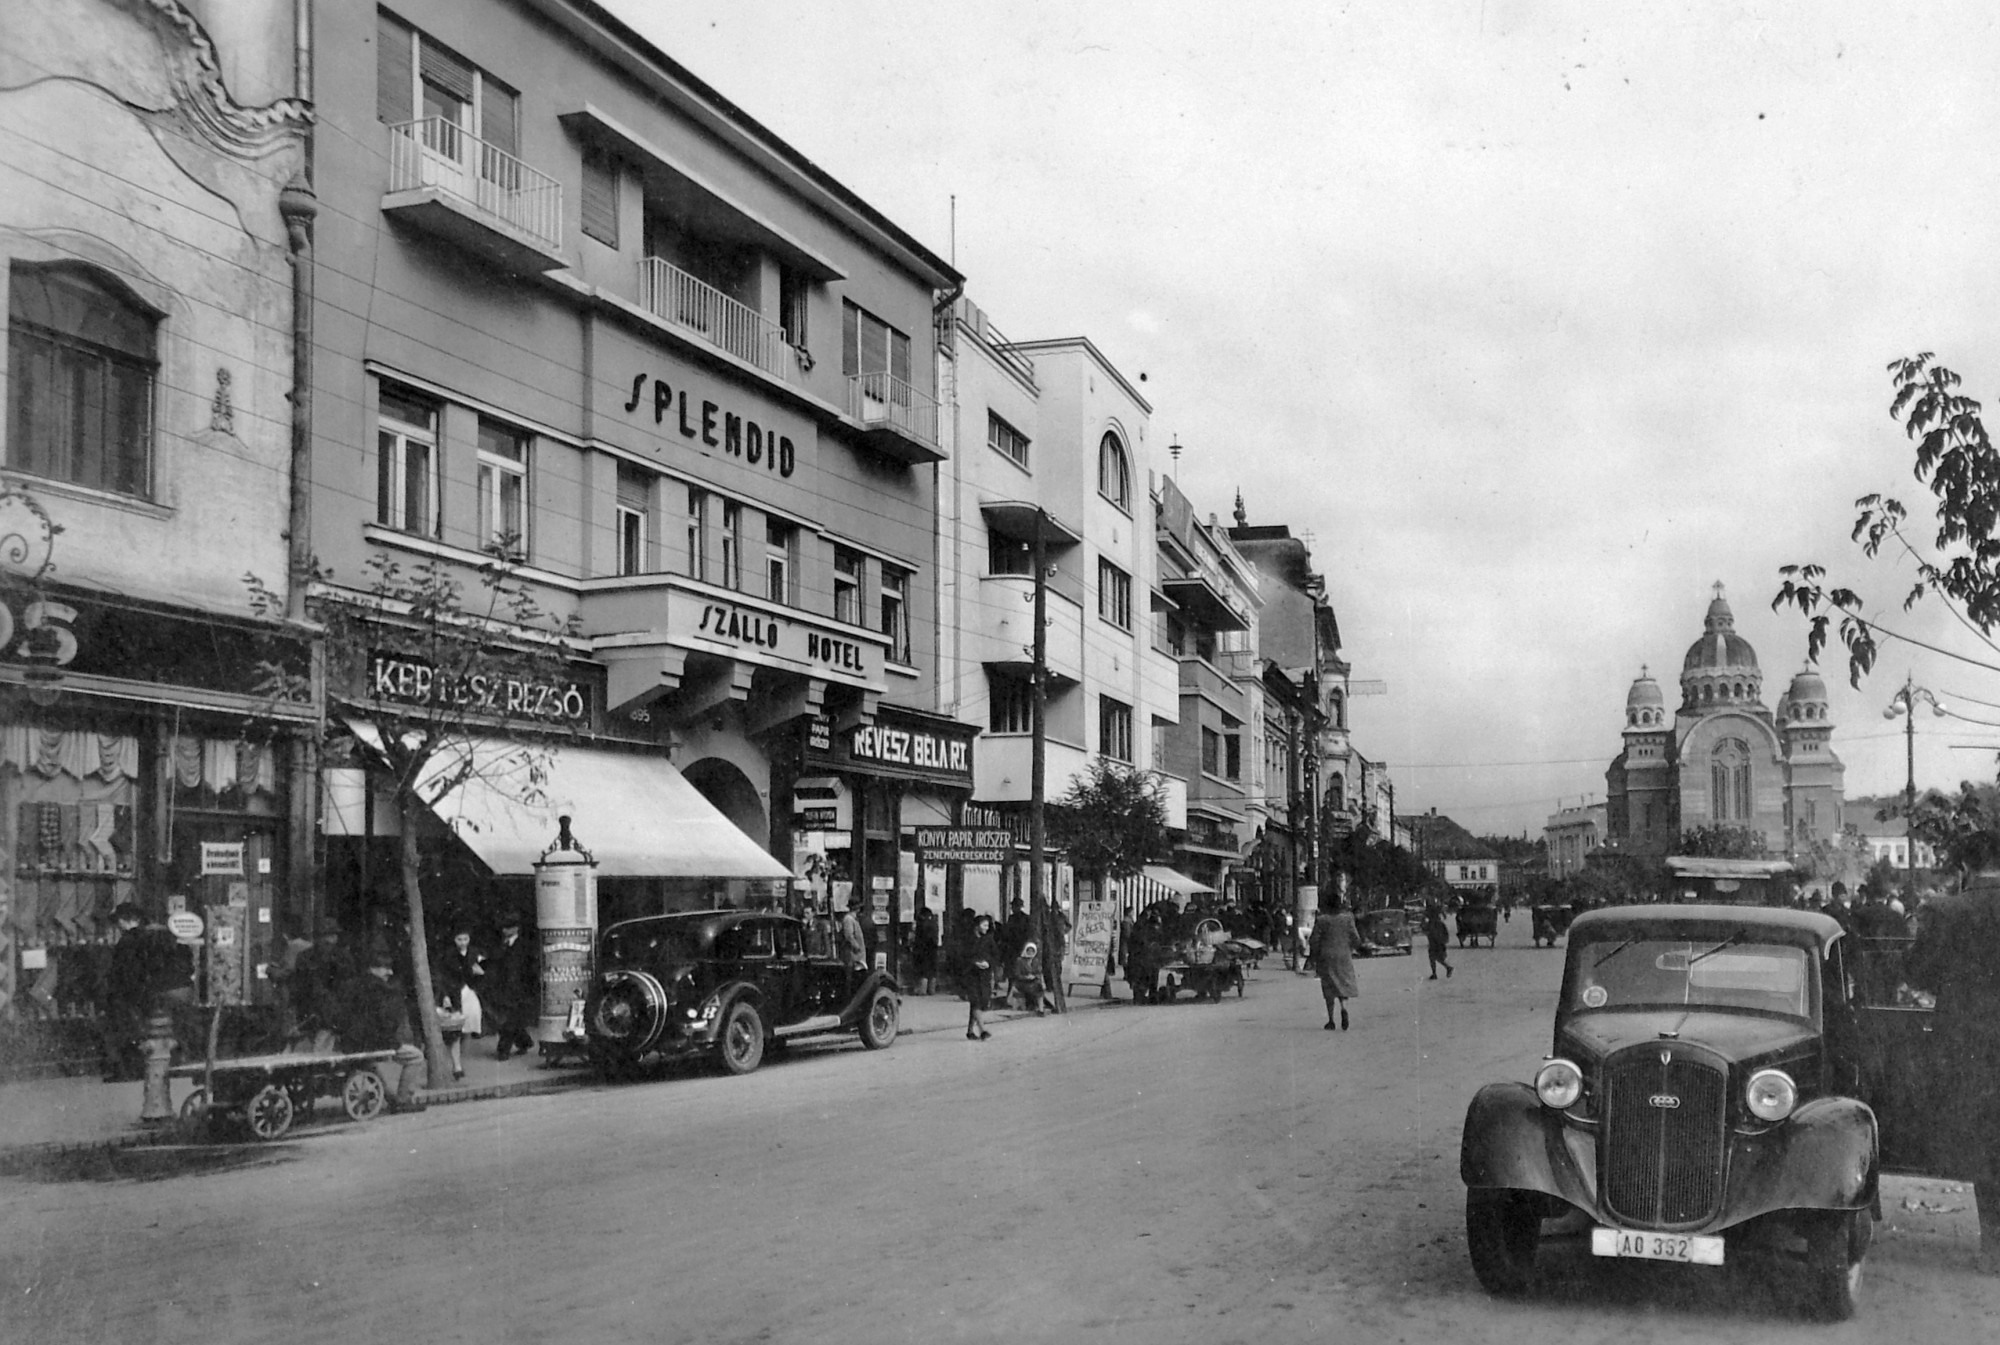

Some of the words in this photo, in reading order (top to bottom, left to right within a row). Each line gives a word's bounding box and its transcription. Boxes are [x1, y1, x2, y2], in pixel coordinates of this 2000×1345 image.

[624, 373, 795, 478] SPLENDID
[699, 604, 778, 649] SZÁLLÓ
[808, 633, 864, 671] HOTEL
[914, 733, 949, 770] BÉLA
